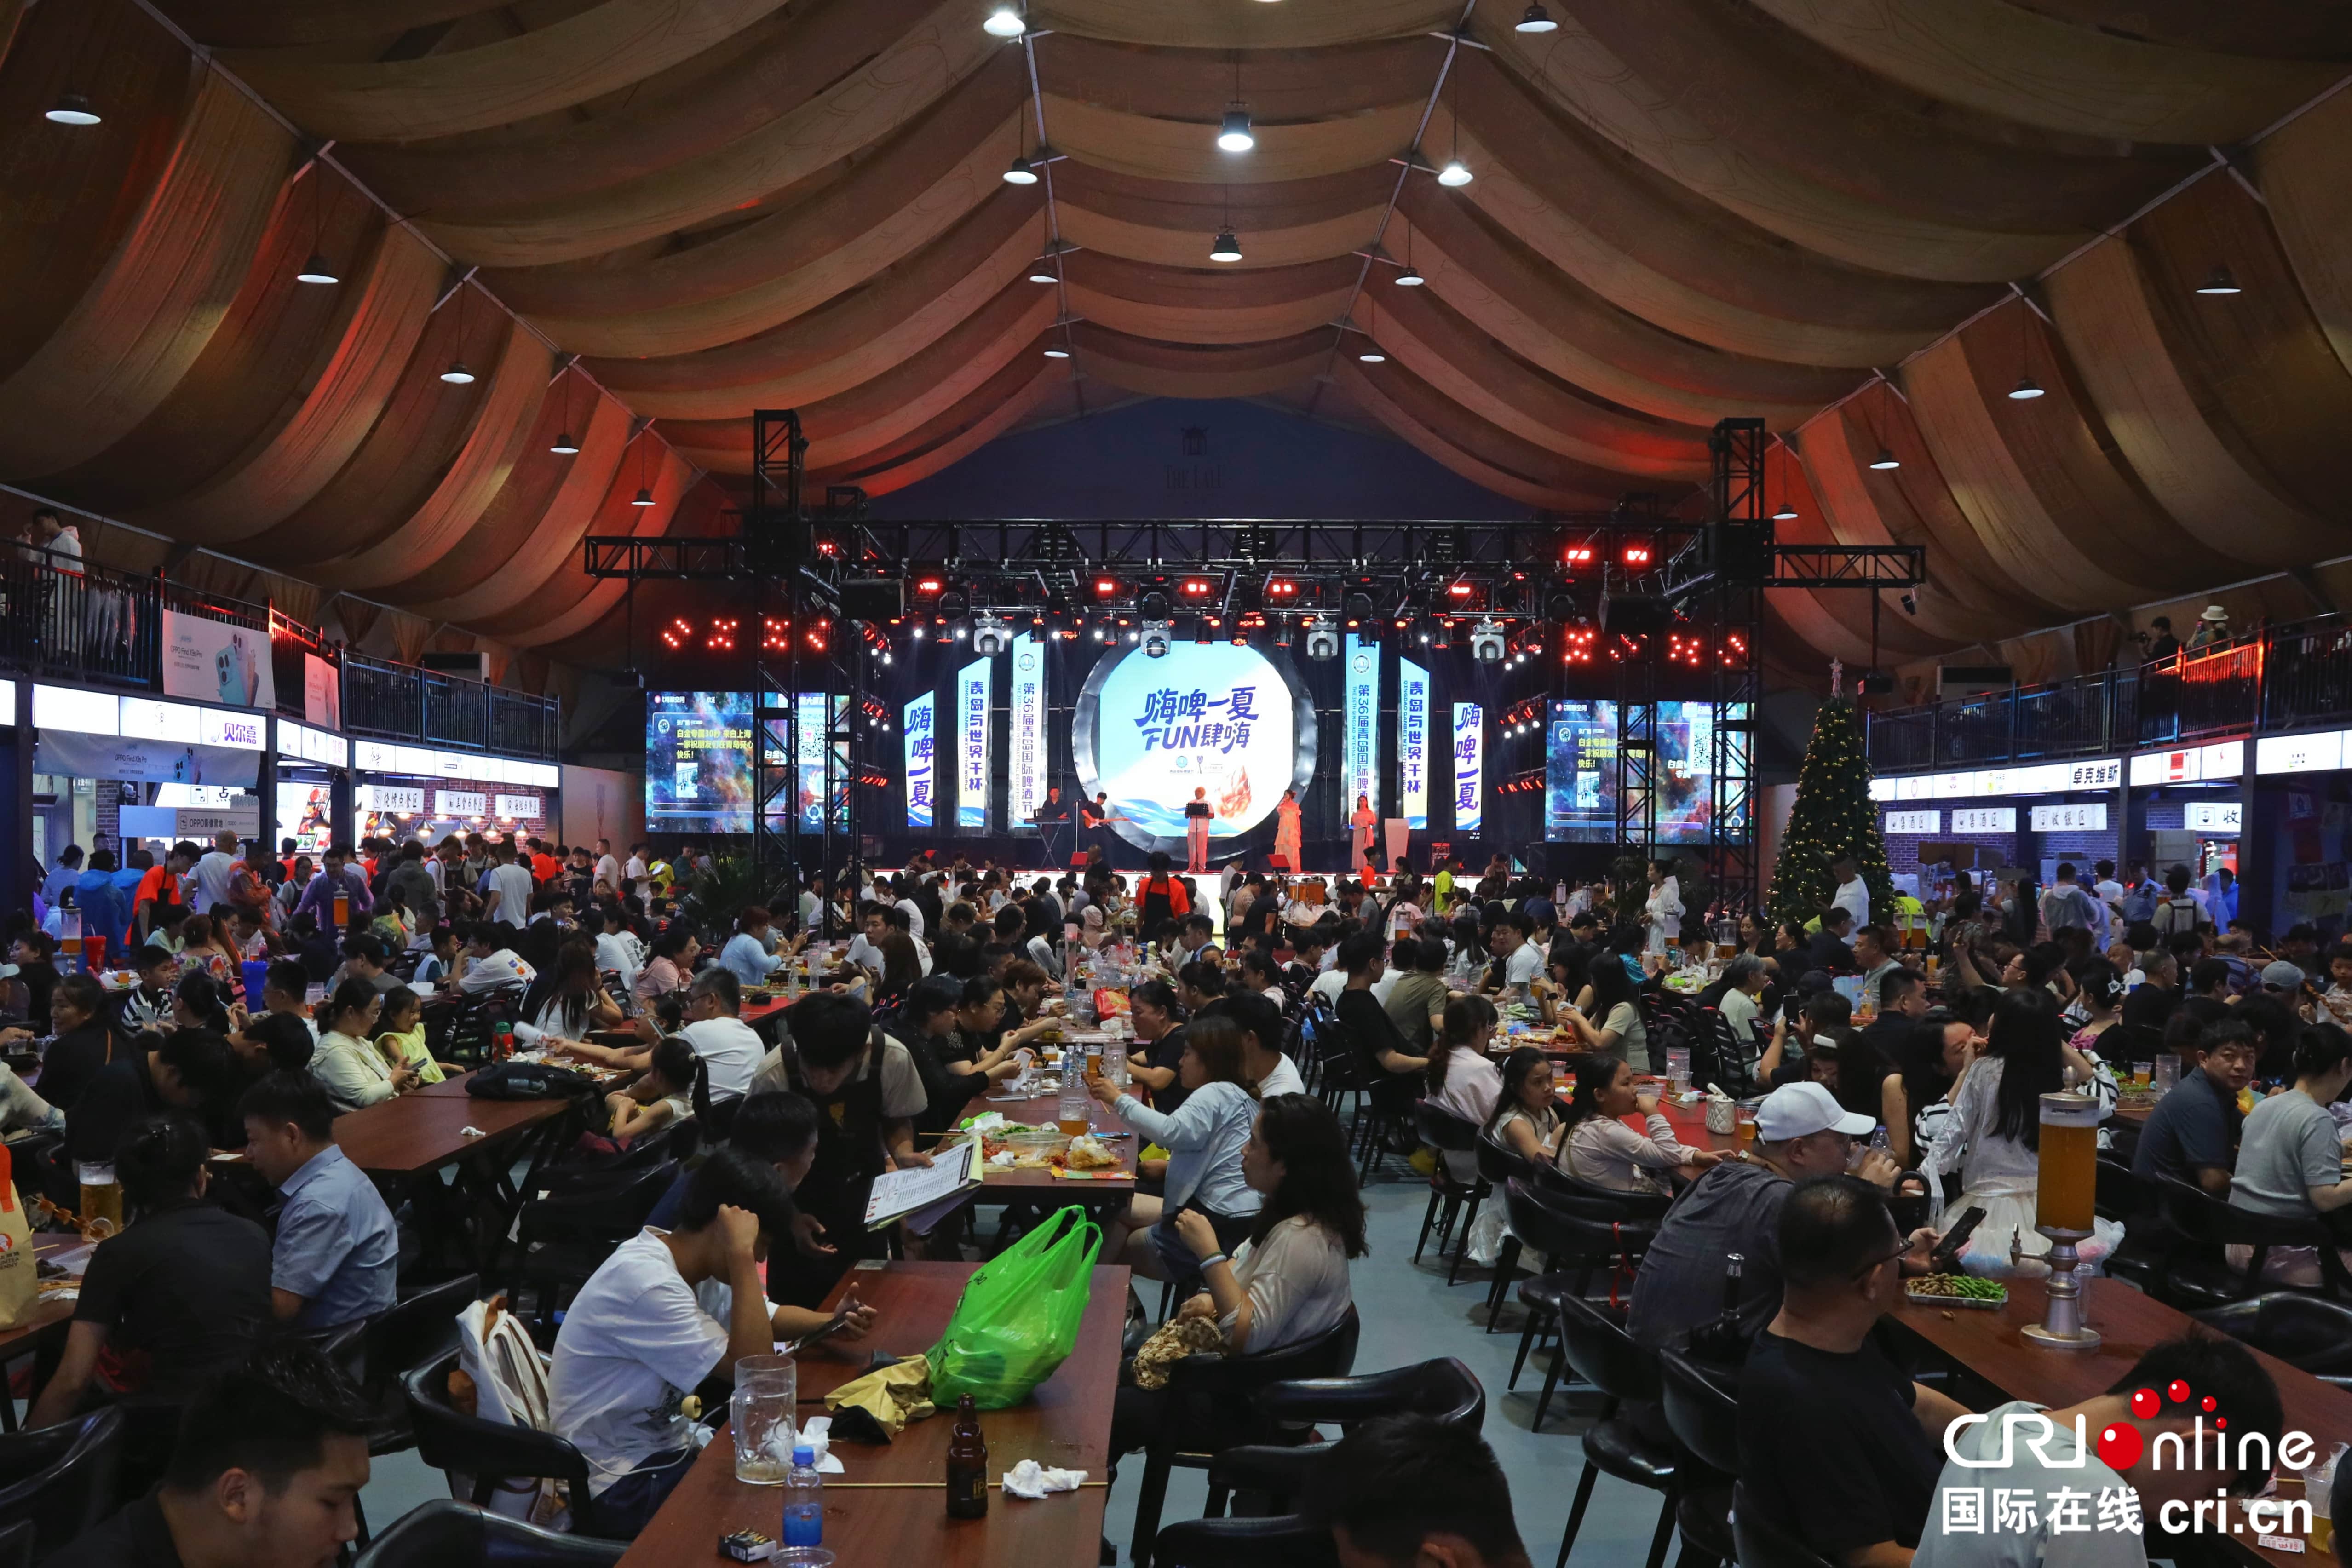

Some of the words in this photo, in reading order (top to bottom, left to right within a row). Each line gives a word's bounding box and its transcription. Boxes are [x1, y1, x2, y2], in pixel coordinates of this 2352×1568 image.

[170, 645, 181, 655] OPPO
[1133, 686, 1259, 727] 嗨啤一夏
[224, 723, 256, 744] 贝尔嘉
[723, 729, 751, 738] 来自上海
[969, 681, 983, 790] 青岛与世界干杯
[1022, 683, 1034, 812] 第36届青岛国际啤酒节
[1142, 721, 1251, 754] FUN肆嗨
[1407, 682, 1423, 793] 青岛与世界干杯
[904, 705, 934, 808] 嗨啤一夏
[1454, 704, 1480, 811] 嗨啤一夏
[2073, 765, 2118, 784] 卓克维斯
[384, 791, 418, 809] 烧烤点餐区
